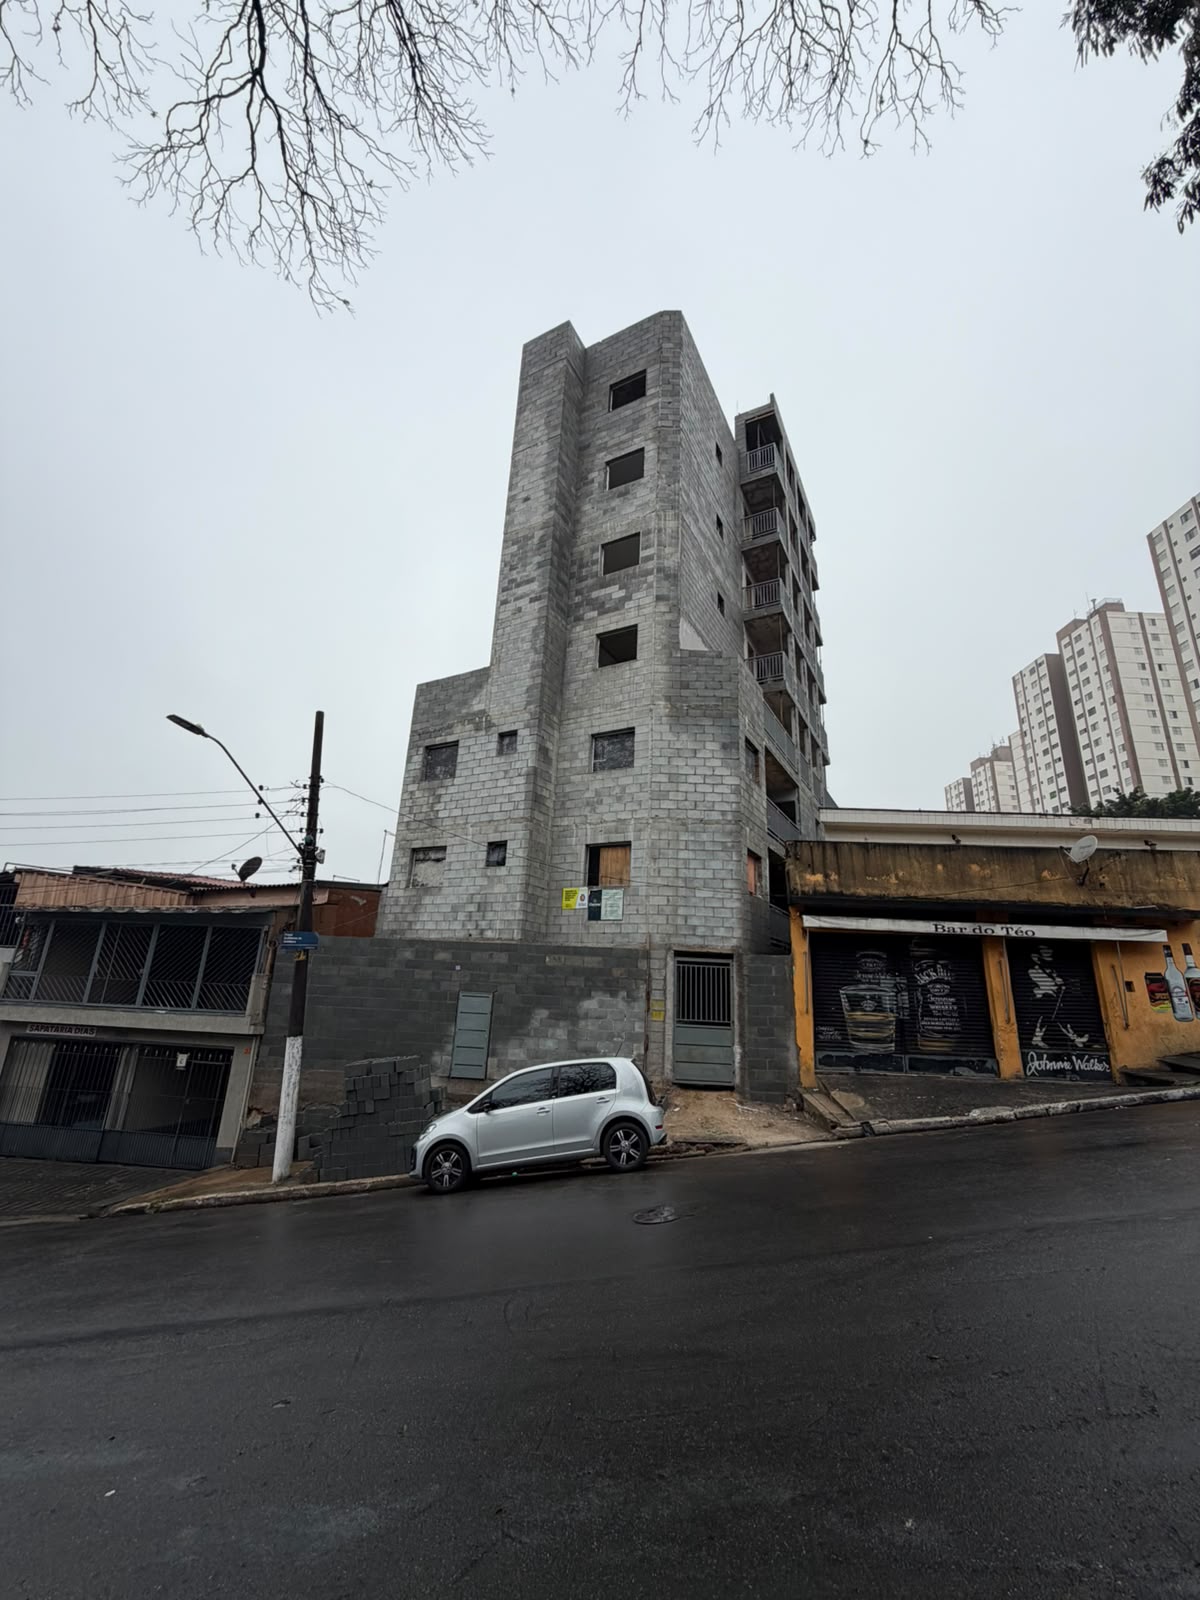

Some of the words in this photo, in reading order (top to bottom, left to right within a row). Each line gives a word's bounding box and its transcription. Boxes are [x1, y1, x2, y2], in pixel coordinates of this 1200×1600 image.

[932, 923, 967, 933] Bar
[972, 925, 995, 935] do
[1001, 926, 1036, 937] Téo
[29, 1024, 73, 1034] SAPATARIA
[74, 1026, 95, 1035] DIAS
[1026, 1051, 1073, 1077] Johnnie
[1072, 1054, 1111, 1073] Walker
